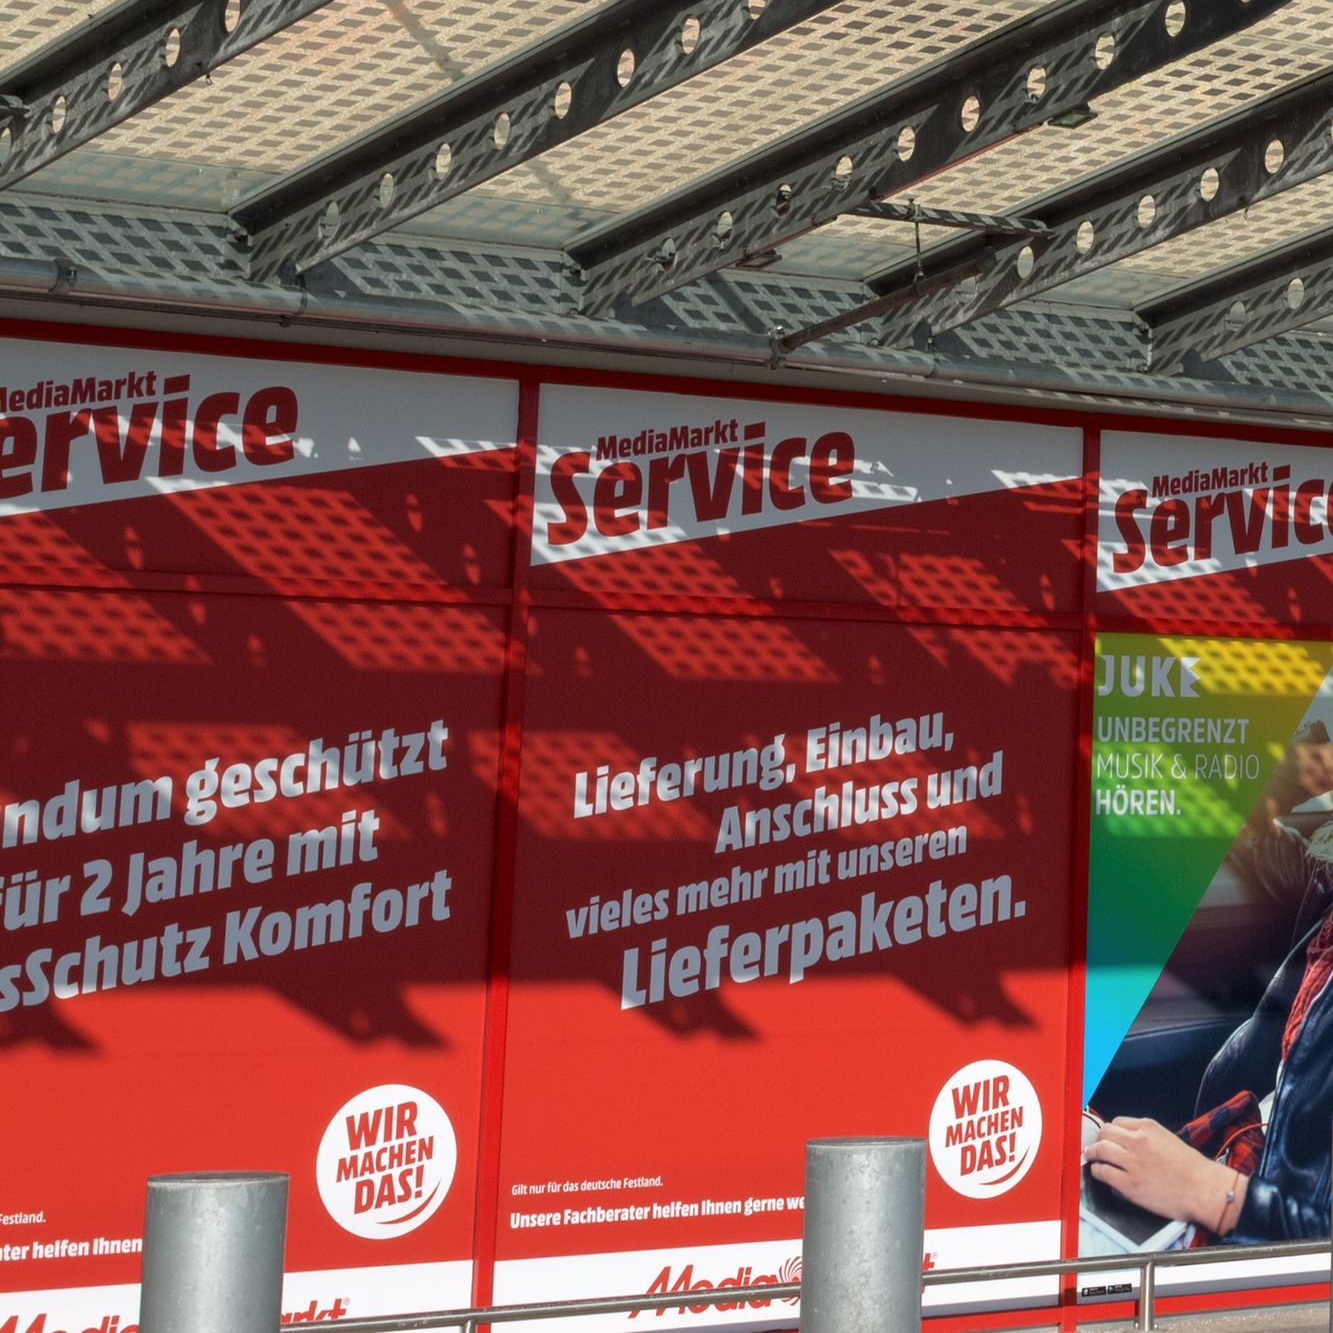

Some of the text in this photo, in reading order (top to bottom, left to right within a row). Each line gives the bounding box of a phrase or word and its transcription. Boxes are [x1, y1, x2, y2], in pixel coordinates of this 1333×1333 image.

[0, 374, 299, 500] ervice
[596, 418, 738, 462] MediaMarkt
[546, 421, 856, 546] Service
[1151, 461, 1269, 499] MediaMarkt
[1096, 716, 1250, 745] UNBEGRENZT
[1, 719, 449, 849] ndum geschützt
[573, 712, 954, 819] Lieferung, Einbau,
[1096, 753, 1261, 781] MUSIK & RADIO
[714, 751, 1004, 854] Anschluss und
[1095, 784, 1182, 817] HÖREN.
[81, 809, 381, 917] 2 Jahre mit
[566, 824, 968, 940] vieles mehr mit unseren
[0, 869, 453, 1013] sSchutz Komfort
[621, 872, 1027, 1010] Lieferpaketen.
[951, 1074, 1011, 1120] WIR
[345, 1100, 419, 1151] WIR
[944, 1105, 1024, 1148] MACHEN
[336, 1135, 435, 1184] MACHEN
[959, 1132, 1017, 1177] DAS!
[353, 1164, 426, 1216] DAS!
[529, 1176, 622, 1195] nur deutsche
[510, 1210, 561, 1230] Unsere
[563, 1204, 651, 1226] Fachberater
[652, 1201, 699, 1220] helfen
[700, 1198, 742, 1217] Ihnen
[743, 1197, 785, 1217] gerne
[32, 1238, 90, 1260] helfen
[92, 1236, 143, 1256] Ihnen
